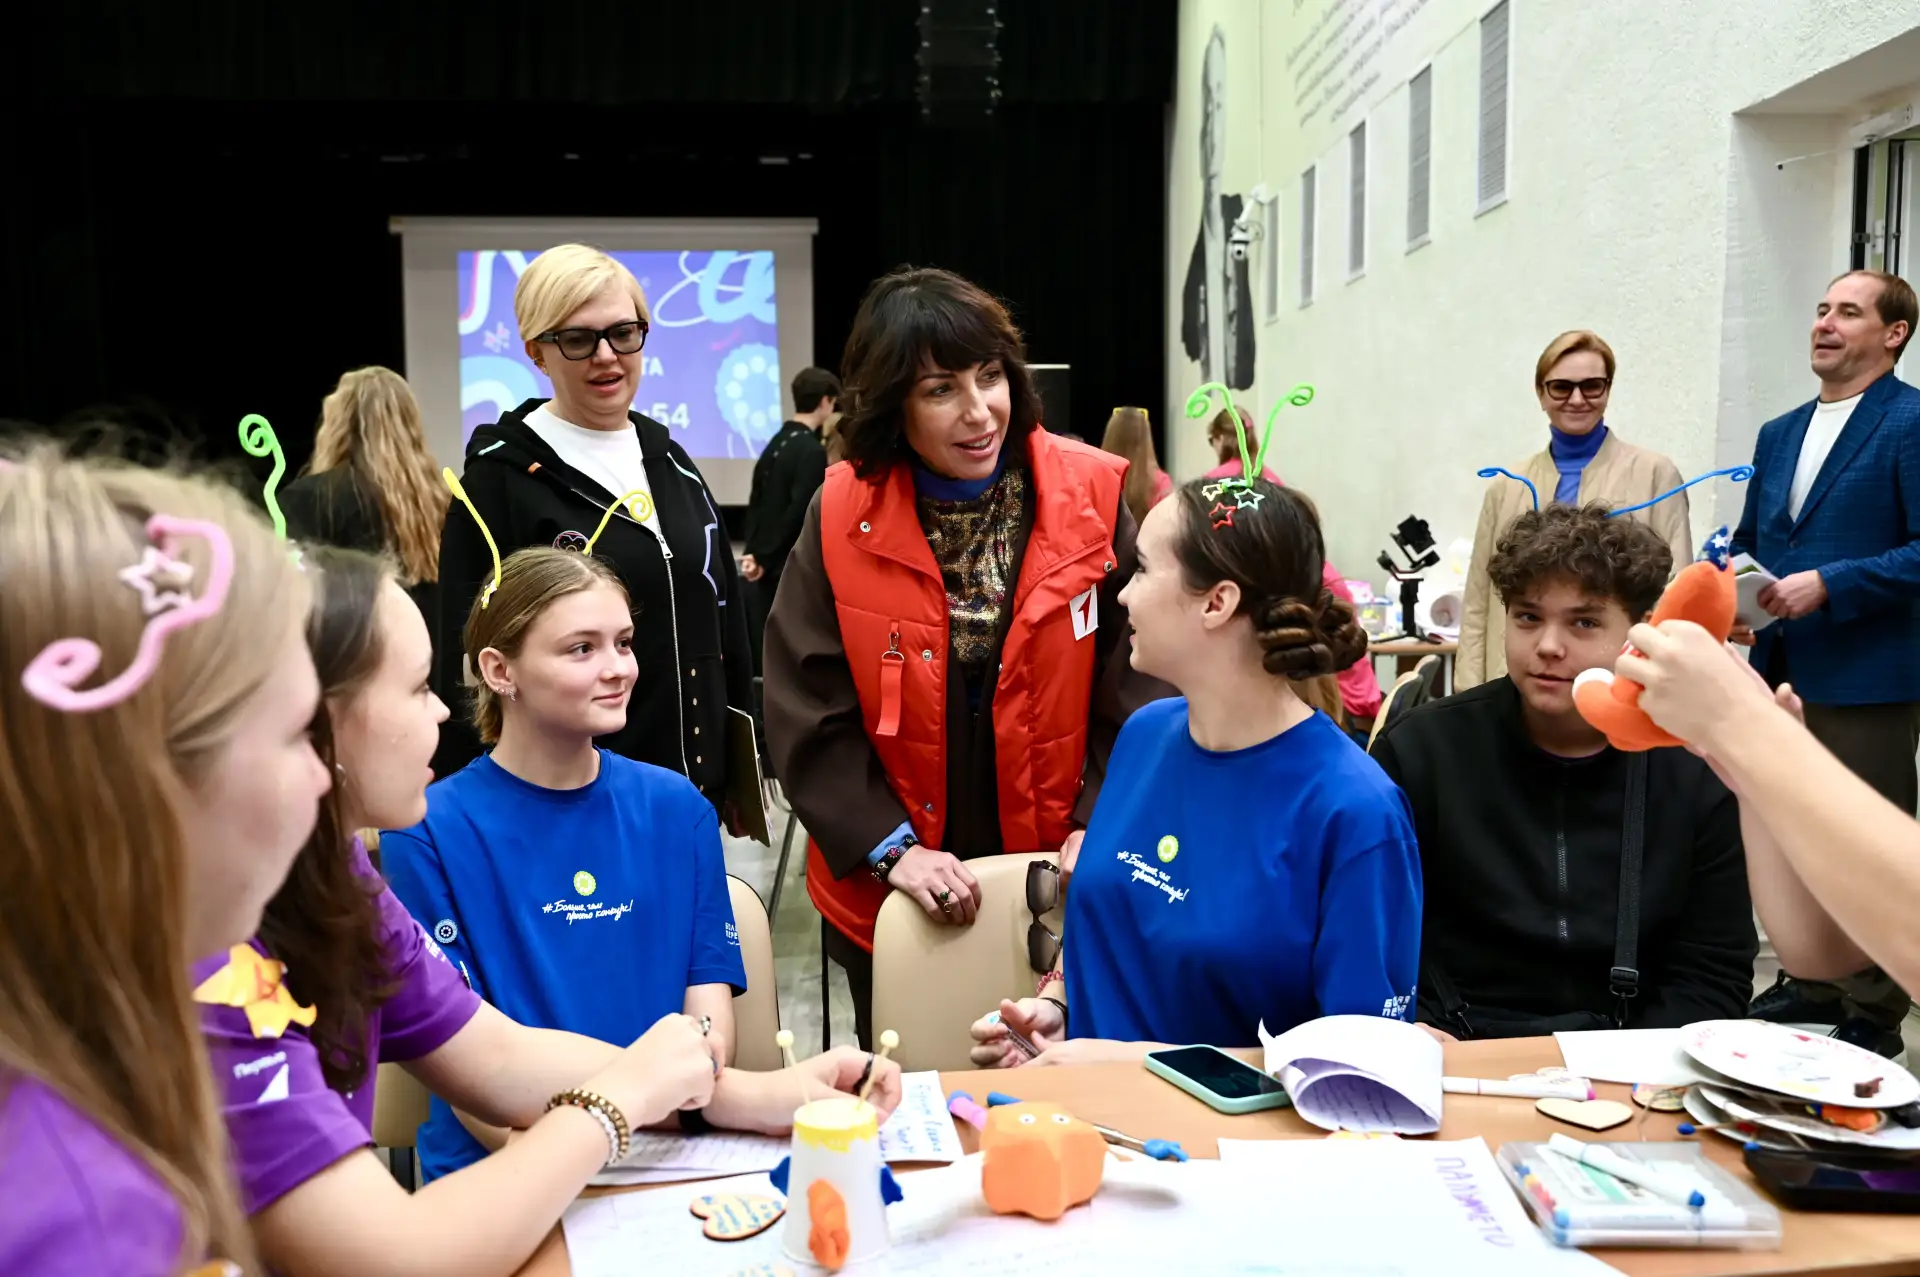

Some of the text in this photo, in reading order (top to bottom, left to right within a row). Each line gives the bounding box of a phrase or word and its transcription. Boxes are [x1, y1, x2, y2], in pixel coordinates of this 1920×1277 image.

[641, 356, 664, 376] ТА
[566, 899, 633, 925] просто конкурс!
